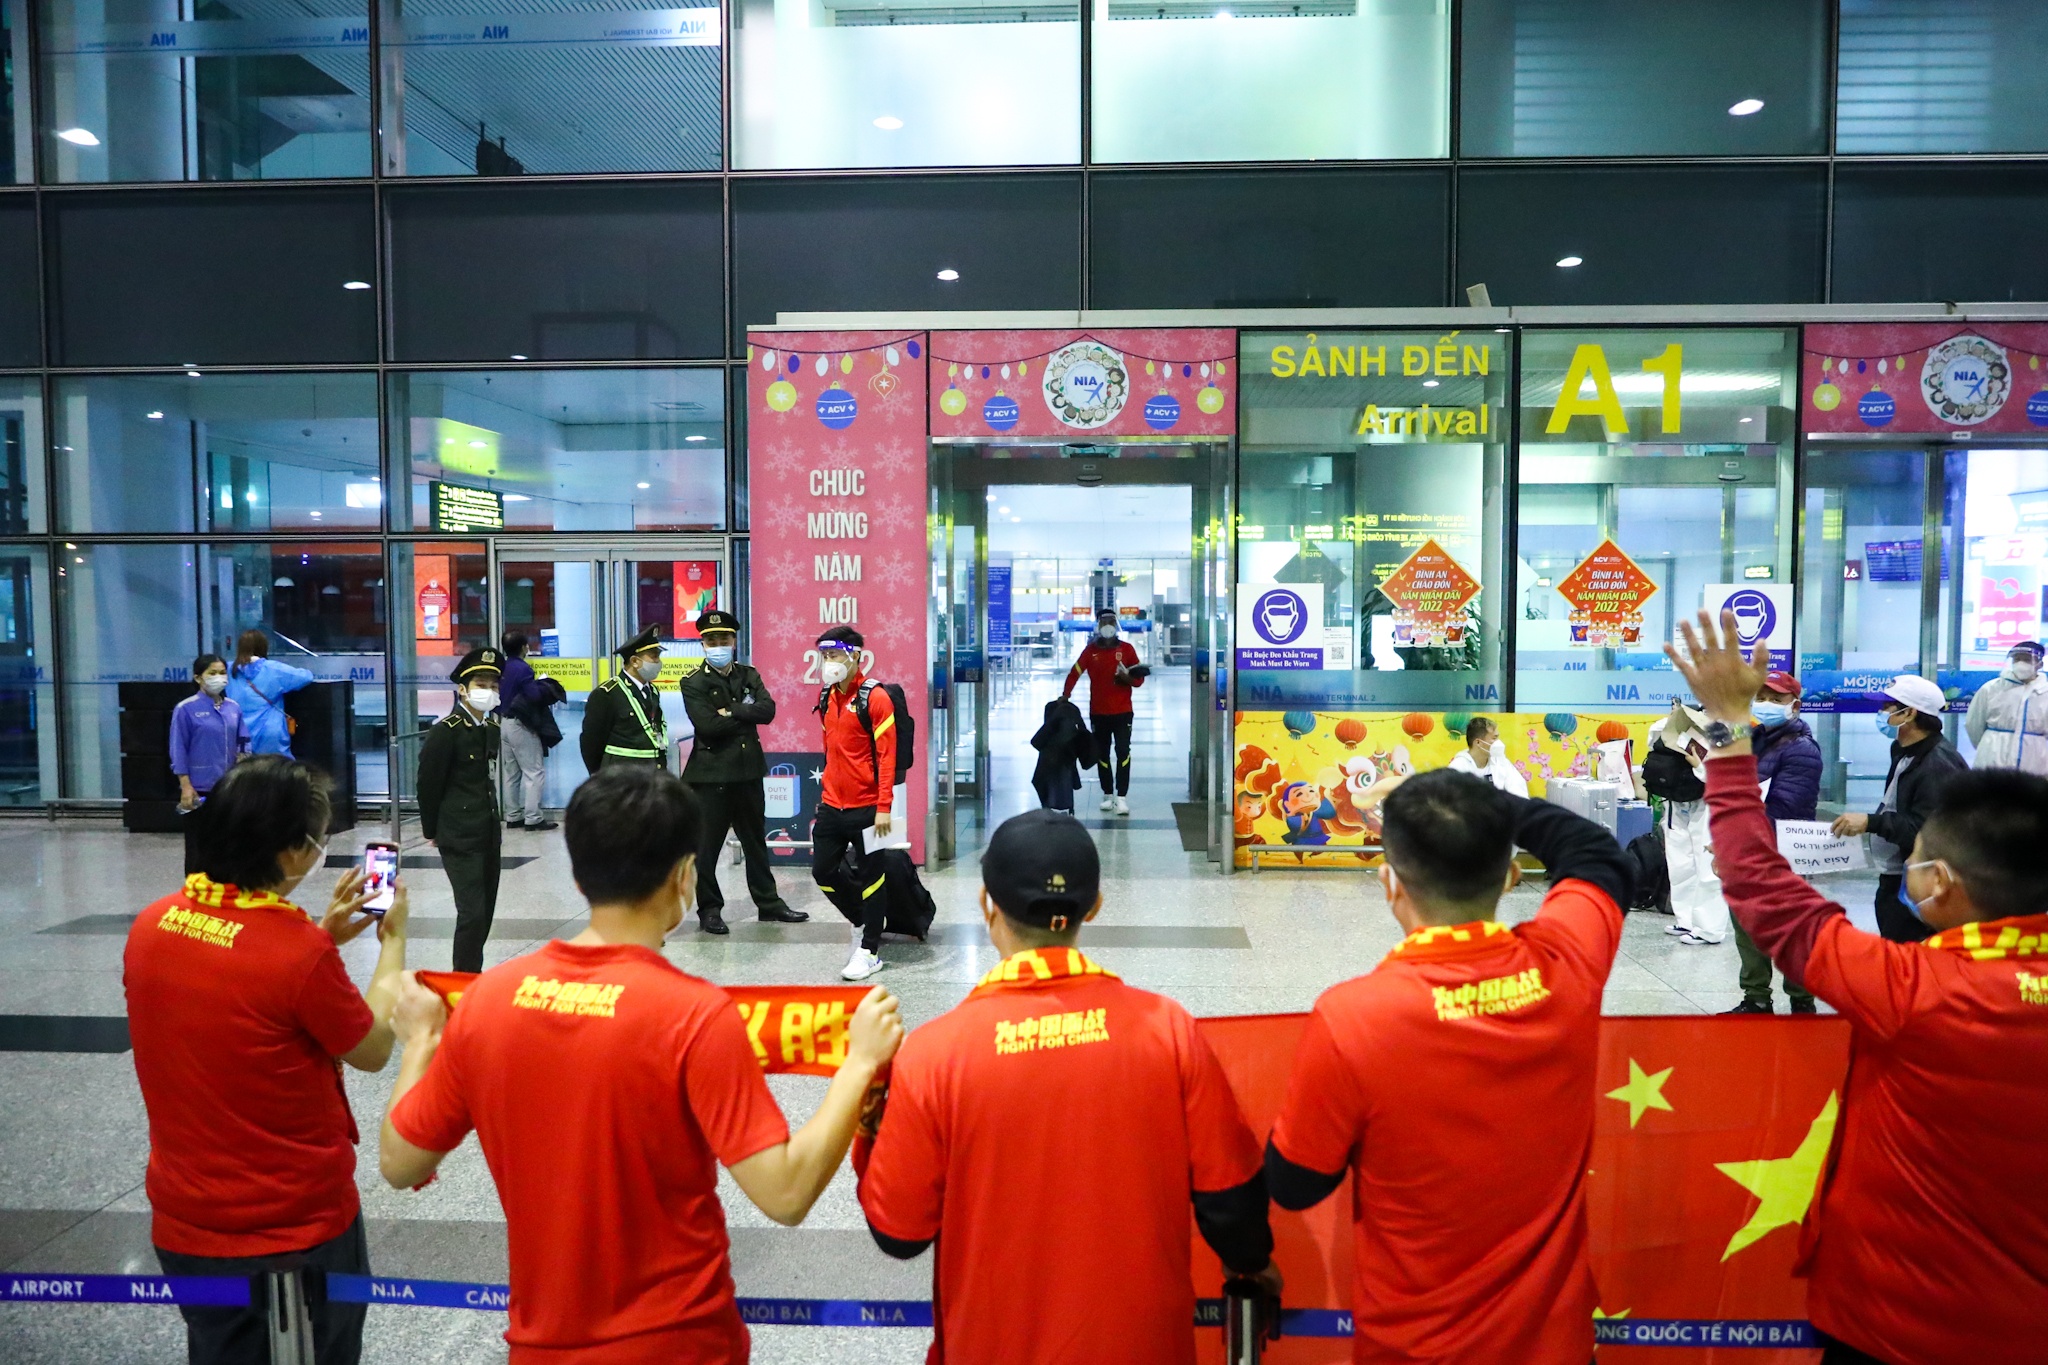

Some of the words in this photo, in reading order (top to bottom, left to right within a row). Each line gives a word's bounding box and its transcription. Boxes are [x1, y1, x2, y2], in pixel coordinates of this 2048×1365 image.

[1271, 333, 1387, 378] SẢNH
[1402, 331, 1489, 376] ĐẾN
[1074, 376, 1097, 386] NIA
[1954, 371, 1978, 381] NIA
[1545, 343, 1682, 434] A1
[828, 405, 846, 414] ACV
[993, 409, 1010, 418] ACV
[1153, 409, 1171, 417] ACV
[1868, 405, 1885, 413] ACV
[1357, 403, 1488, 435] Arrival
[809, 466, 865, 496] CHÚC
[807, 509, 868, 539] MỪNG
[814, 551, 862, 581] NĂM
[1612, 571, 1624, 579] AN
[819, 594, 857, 624] MỚI
[1417, 600, 1442, 612] 2022
[1593, 601, 1619, 612] 2022
[1300, 651, 1318, 660] Trang
[1251, 686, 1282, 700] NIA
[1466, 684, 1498, 700] NIA
[1607, 684, 1640, 700] NIA
[1823, 841, 1846, 850] JUNG
[1795, 857, 1820, 867] Visa
[1824, 856, 1850, 864] Asia
[157, 920, 184, 934] FIGHT
[183, 927, 203, 940] FOR
[202, 932, 234, 949] CHINA
[512, 995, 551, 1011] FIGHT
[548, 999, 576, 1014] FOR
[575, 1002, 615, 1019] CHINA
[1477, 1000, 1507, 1016] FOR
[996, 1038, 1036, 1055] FIGHT
[1038, 1033, 1065, 1050] FOR
[1068, 1028, 1110, 1046] CHINA
[11, 1280, 85, 1297] AIRPORT
[131, 1282, 174, 1299] N.I.A
[371, 1282, 416, 1299] N.I.A
[861, 1306, 906, 1322] N.I.A
[1635, 1321, 1692, 1341] QUỐC
[1699, 1321, 1724, 1341] TẾ
[1728, 1323, 1763, 1345] NỘI
